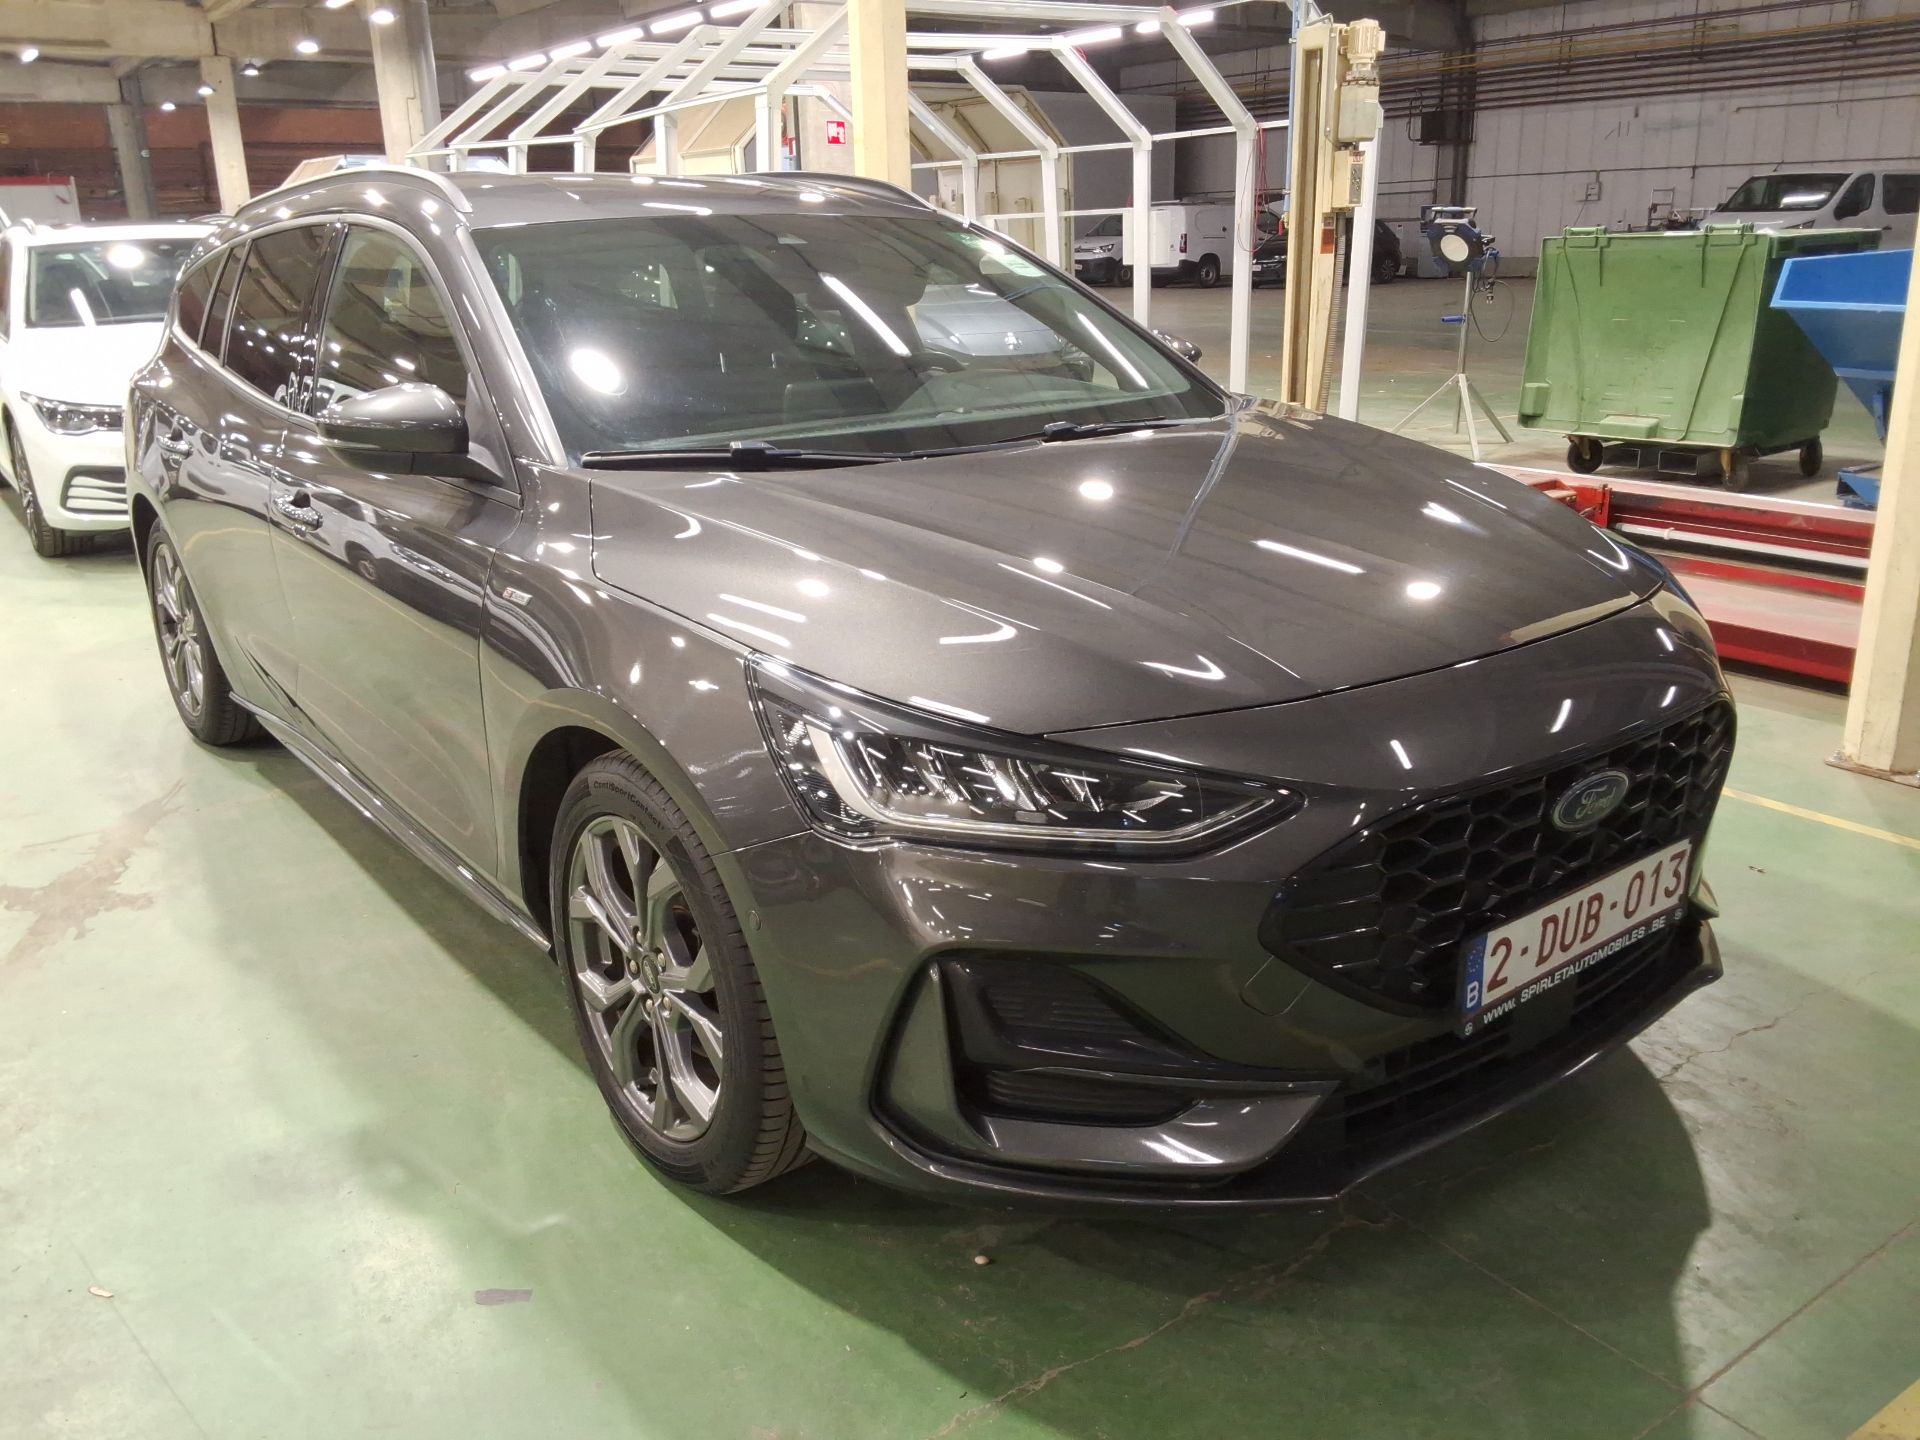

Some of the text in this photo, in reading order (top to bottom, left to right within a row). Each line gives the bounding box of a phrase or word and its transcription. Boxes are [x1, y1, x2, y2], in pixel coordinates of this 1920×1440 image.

[1575, 784, 1617, 820] Ford
[1487, 850, 1687, 993] 2-DUB-013
[1466, 981, 1480, 1009] B
